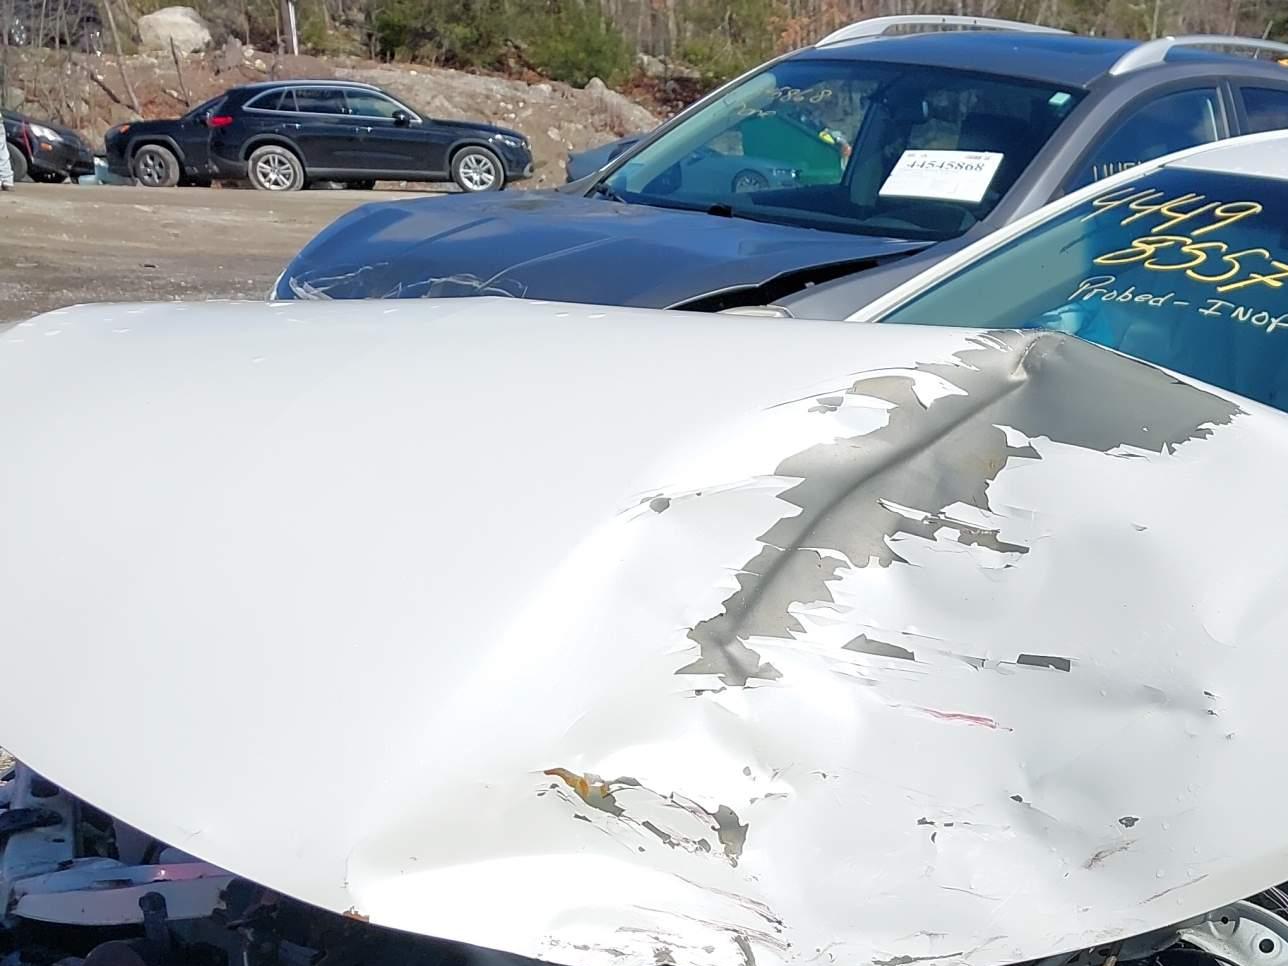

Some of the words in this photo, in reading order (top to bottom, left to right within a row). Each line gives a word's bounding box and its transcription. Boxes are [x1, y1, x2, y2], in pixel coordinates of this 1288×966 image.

[906, 159, 985, 172] 44545868
[1081, 187, 1264, 236] 4449
[1067, 275, 1175, 307] Probed
